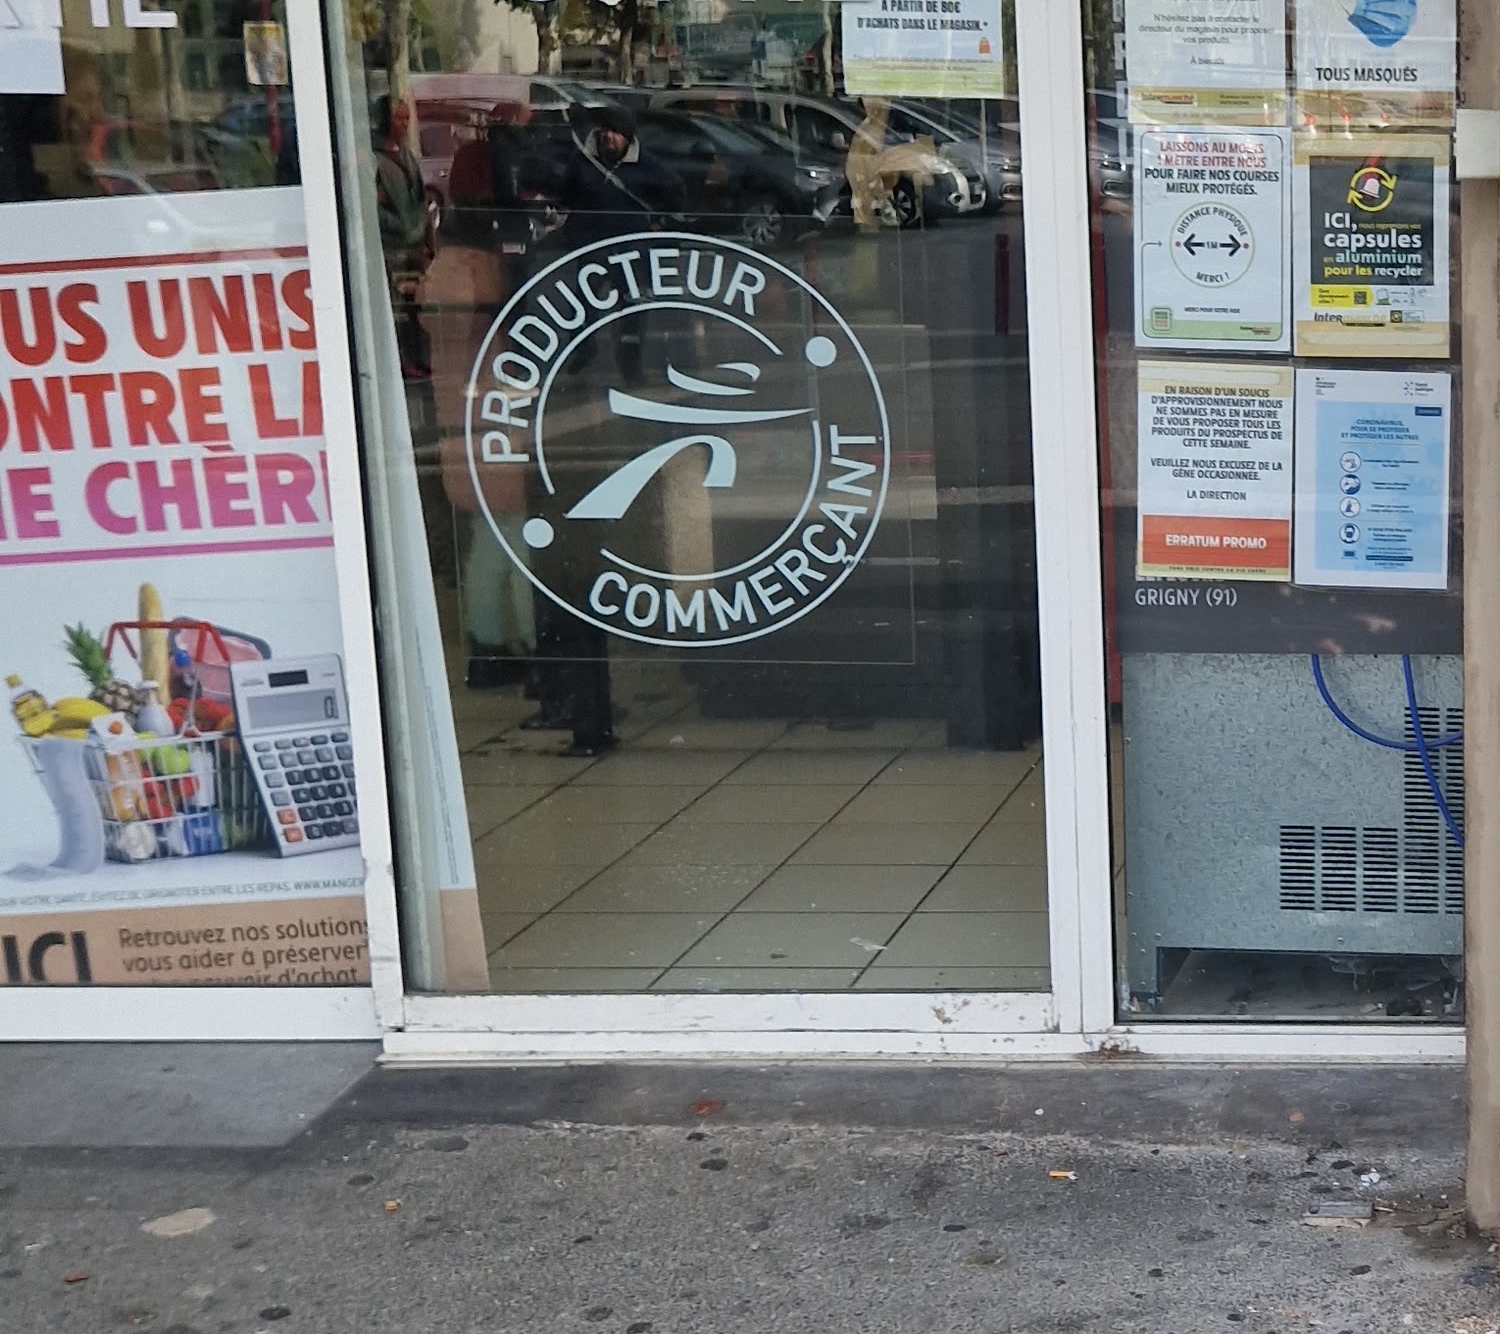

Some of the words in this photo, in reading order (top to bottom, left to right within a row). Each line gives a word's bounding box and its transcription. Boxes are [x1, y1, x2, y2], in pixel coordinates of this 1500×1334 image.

[890, 0, 924, 13] PARTIR
[926, 0, 939, 13] DE
[927, 18, 938, 30] LE
[1315, 67, 1350, 81] TOUS
[1354, 66, 1418, 83] MASQUÉS
[1160, 141, 1209, 153] LAISSONS
[1212, 142, 1226, 153] AU
[1202, 156, 1235, 167] ENTRE
[1237, 156, 1267, 168] NOUS
[1144, 168, 1174, 179] POUR
[1177, 169, 1206, 180] FAIRE
[1209, 169, 1230, 181] NOS
[1233, 170, 1279, 182] COURSES
[1166, 182, 1200, 194] MIEUX
[1177, 206, 1211, 235] DISTANCE
[1212, 207, 1249, 237] PHYSIQUE
[1324, 212, 1358, 232] ICI,
[1323, 228, 1422, 252] capsules
[1335, 249, 1422, 264] aluminium
[1196, 271, 1224, 283] MERCI
[1324, 266, 1353, 277] pour
[1355, 265, 1373, 276] les
[1374, 265, 1423, 278] recycler
[127, 269, 316, 360] UNIS
[481, 247, 767, 463] PRODUCTEUR
[1164, 385, 1177, 395] EN
[1179, 385, 1212, 396] RAISON
[1214, 387, 1237, 397] D'UN
[1239, 387, 1270, 398] SOUCIS
[1151, 395, 1257, 409] D'APPROVISIONNEMENT
[1258, 399, 1283, 409] NOUS
[0, 367, 230, 455] NTRE
[1156, 405, 1168, 416] NE
[1170, 406, 1208, 417] SOMMES
[1210, 408, 1226, 418] PAS
[1228, 408, 1241, 418] EN
[1242, 409, 1278, 419] MESURE
[1152, 416, 1165, 426] DE
[1166, 416, 1190, 427] VOUS
[1192, 417, 1240, 428] PROPOSER
[1242, 419, 1265, 429] TOUS
[1266, 420, 1282, 430] LES
[1151, 426, 1196, 437] PRODUITS
[1197, 428, 1211, 438] DU
[1213, 429, 1269, 440] PROSPECTUS
[1270, 430, 1283, 440] DE
[1182, 438, 1208, 448] CETTE
[1150, 457, 1190, 468] VEUILLEZ
[1192, 459, 1217, 469] NOUS
[1219, 460, 1257, 470] EXCUSEZ
[1258, 461, 1271, 471] DE
[1271, 462, 1283, 471] LA
[85, 444, 333, 536] CHÈR
[1186, 489, 1198, 499] LA
[1199, 490, 1247, 501] DIRECTION
[590, 424, 878, 634] COMMERÇANT
[1165, 534, 1220, 548] ERRATUM
[1222, 536, 1268, 549] PROMO
[1134, 588, 1200, 606] GRIGNY
[1205, 586, 1238, 607] (91)
[118, 926, 226, 948] Retrouvez
[232, 924, 271, 942] nos
[275, 917, 368, 940] solution
[123, 954, 174, 972] vous
[179, 948, 235, 970] aider
[241, 947, 256, 966] à
